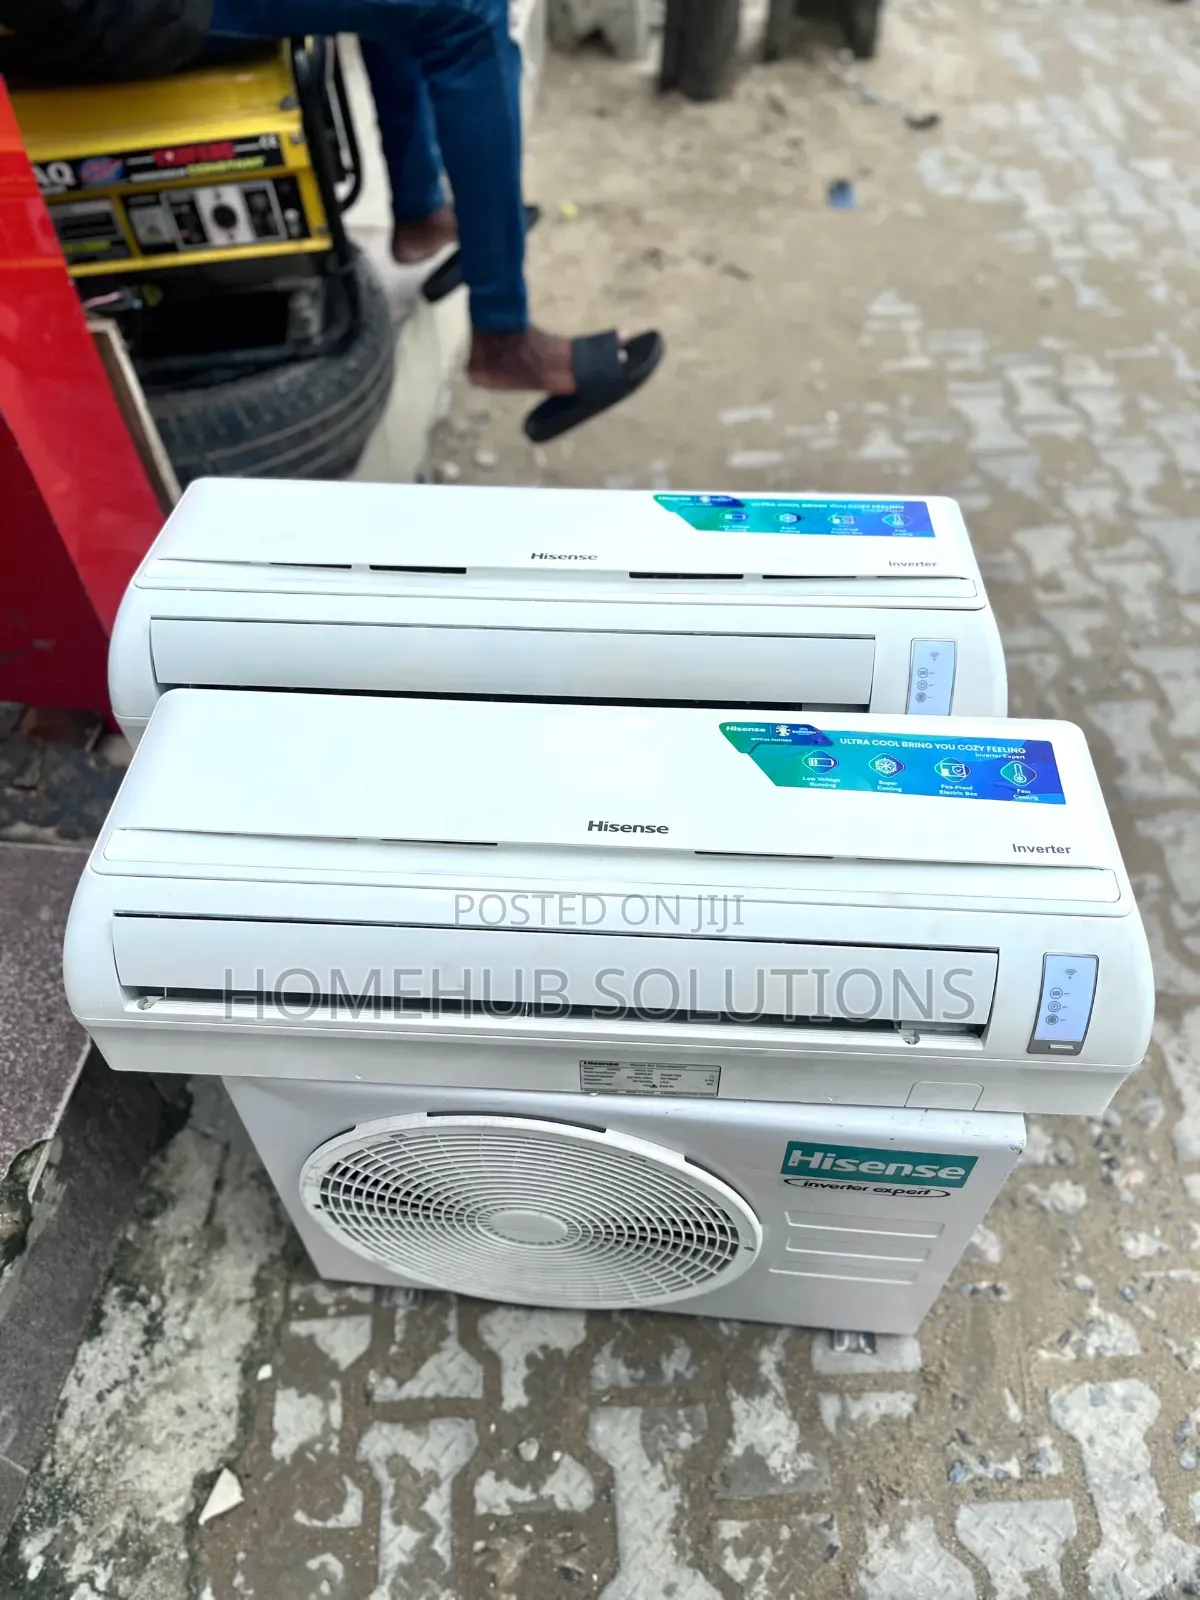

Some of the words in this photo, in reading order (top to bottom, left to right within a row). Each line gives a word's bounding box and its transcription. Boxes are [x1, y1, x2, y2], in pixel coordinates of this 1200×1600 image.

[530, 552, 598, 561] Hisense
[888, 560, 937, 568] Inverter
[726, 725, 766, 733] Hisense
[840, 737, 870, 746] ULTRA
[872, 739, 900, 747] COOL
[901, 740, 933, 749] BRING
[935, 742, 955, 751] YOU
[957, 743, 985, 753] COZY
[987, 745, 1026, 754] FEELING
[587, 820, 669, 834] Hisense
[1012, 843, 1072, 854] Inverter
[788, 1150, 966, 1180] Hisense
[803, 1180, 869, 1193] inverter
[872, 1185, 931, 1197] expert
